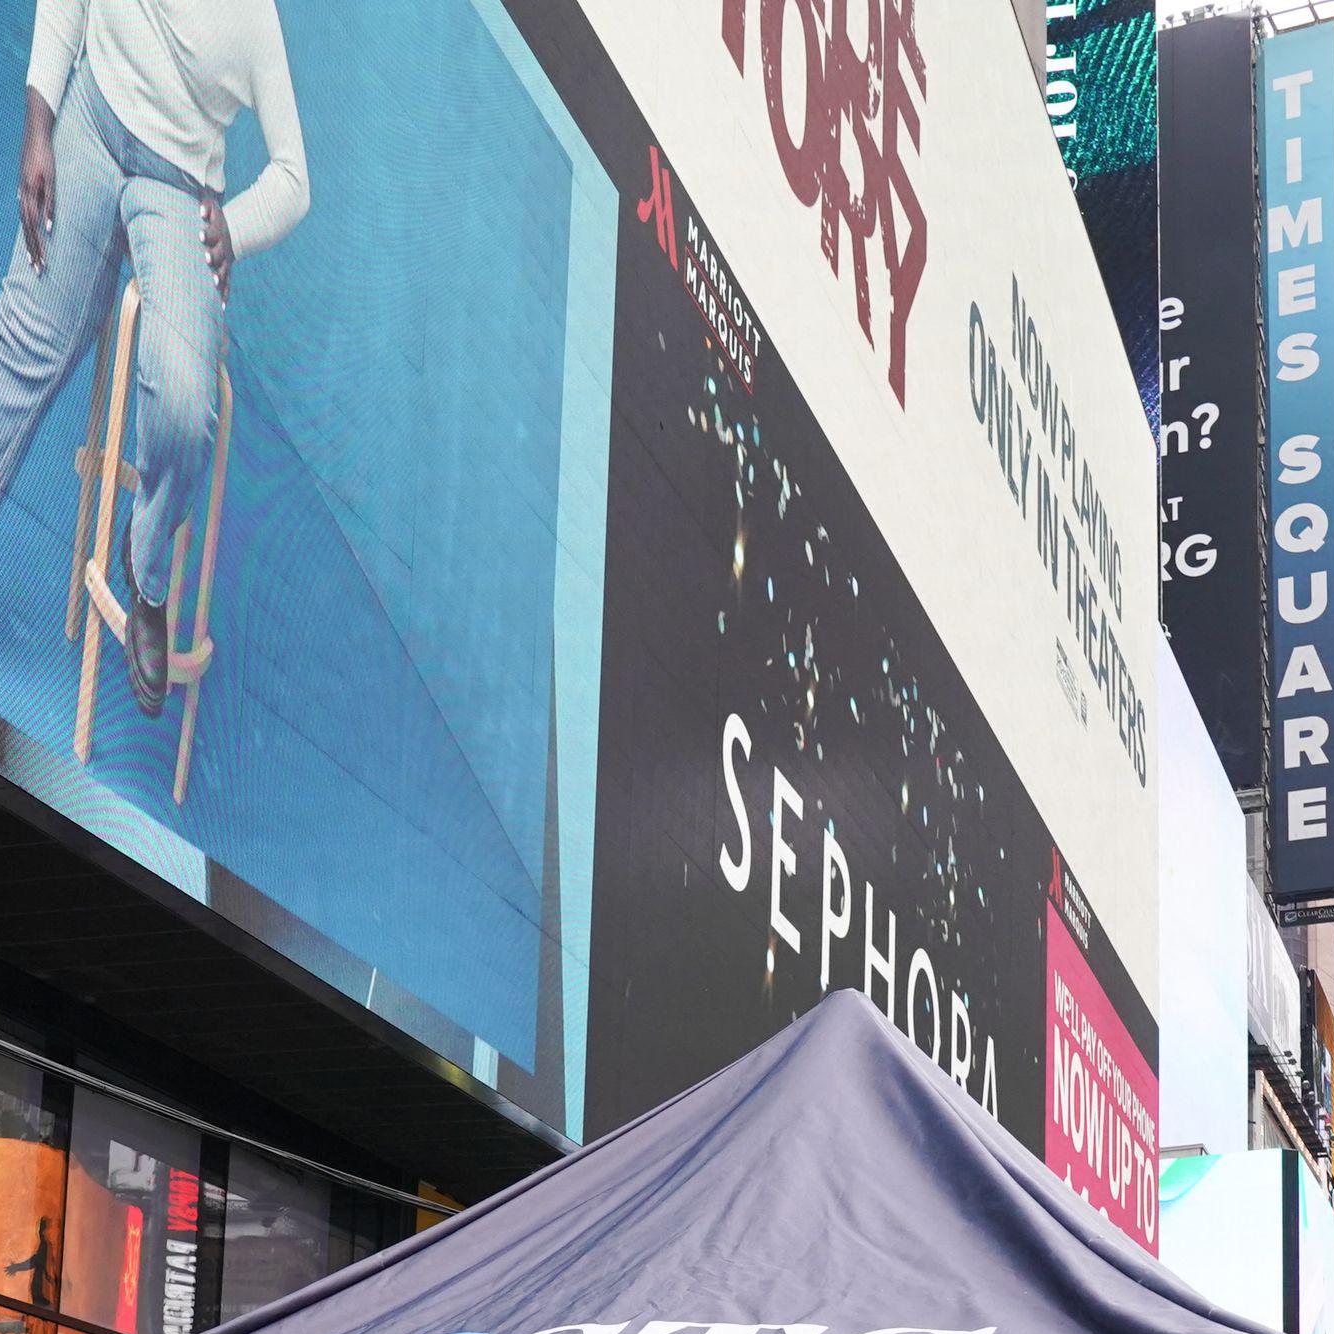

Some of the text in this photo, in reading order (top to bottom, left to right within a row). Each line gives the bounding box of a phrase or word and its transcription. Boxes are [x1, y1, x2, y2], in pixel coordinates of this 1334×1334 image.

[685, 257, 752, 384] MARQUIS
[687, 216, 761, 357] MARRIOTT
[1267, 70, 1324, 384] TIMES
[970, 301, 1032, 520] ONLY
[1038, 453, 1059, 593] IN
[1063, 514, 1146, 789] THEATERS
[1012, 271, 1058, 458] NOW
[1062, 399, 1122, 624] PLAYING
[1273, 433, 1333, 841] SQUARE
[720, 714, 1000, 1121] SEPHORA
[1063, 897, 1089, 950] MARQUIS
[1064, 871, 1092, 930] MARRIOTT
[1053, 970, 1156, 1155] WE'LL PAY OFF YOUR PHONE
[1053, 1024, 1106, 1179] NOW
[1108, 1101, 1133, 1210] UP
[1134, 1140, 1156, 1244] TO
